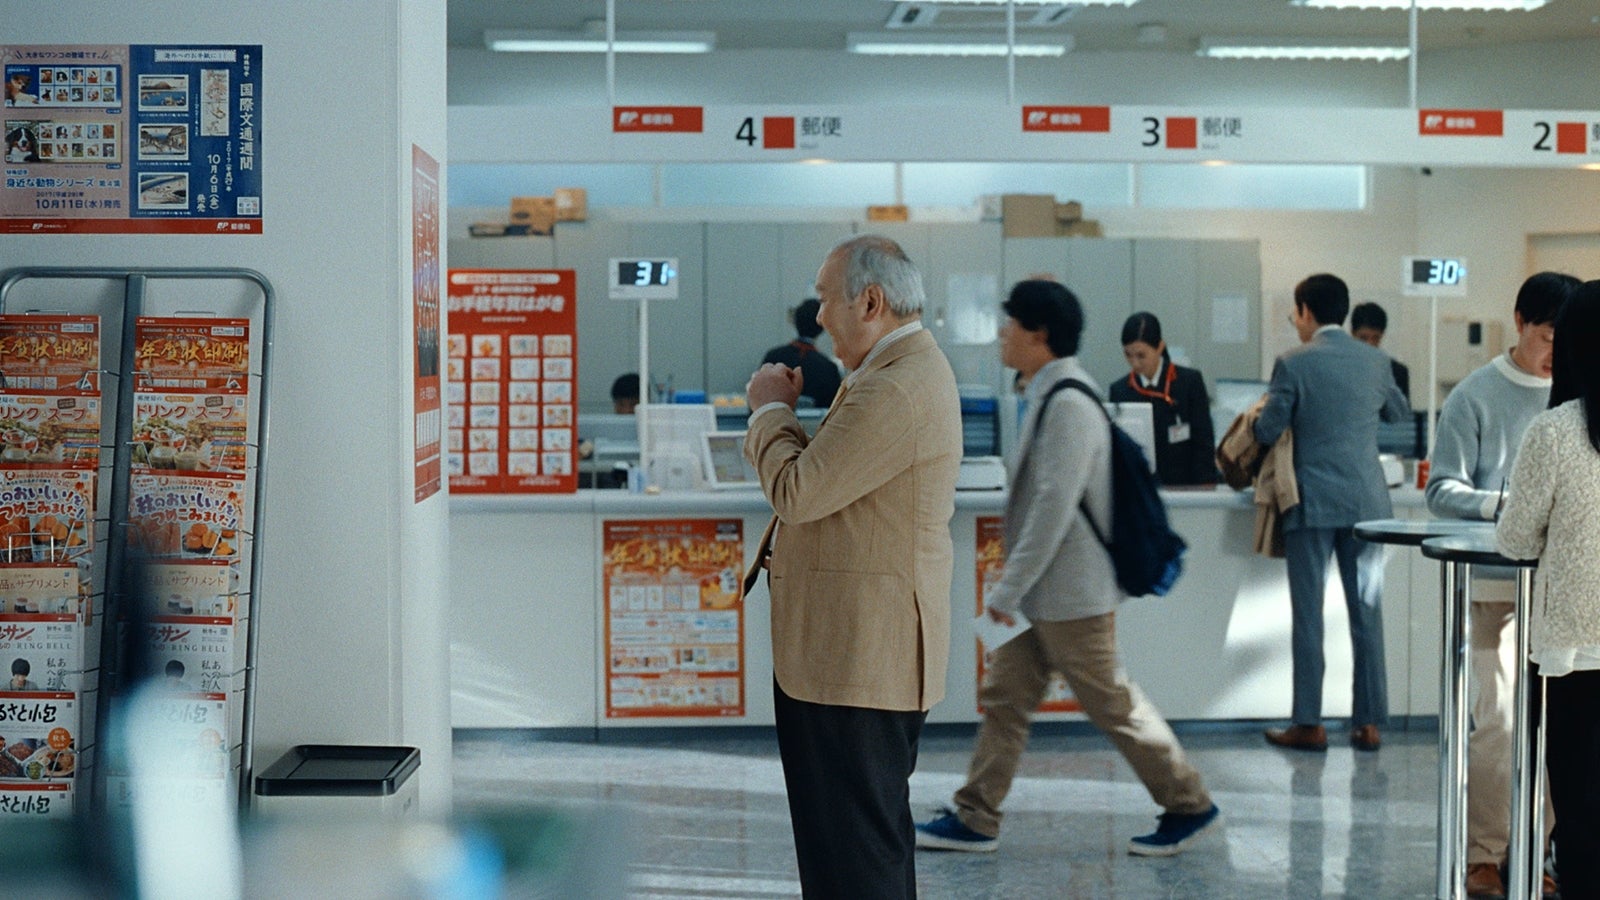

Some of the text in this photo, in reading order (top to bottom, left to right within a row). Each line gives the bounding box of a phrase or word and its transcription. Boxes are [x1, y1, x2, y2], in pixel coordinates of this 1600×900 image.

[735, 116, 842, 146] 4 郵便
[1142, 116, 1242, 146] 3 郵便
[1533, 121, 1552, 150] 2
[6, 178, 94, 187] 身近な動物シリーズ
[36, 199, 121, 209] 10月11日(水)発売
[635, 261, 669, 286] 31
[1428, 260, 1459, 284] 30
[140, 340, 243, 364] 年賀状印刷
